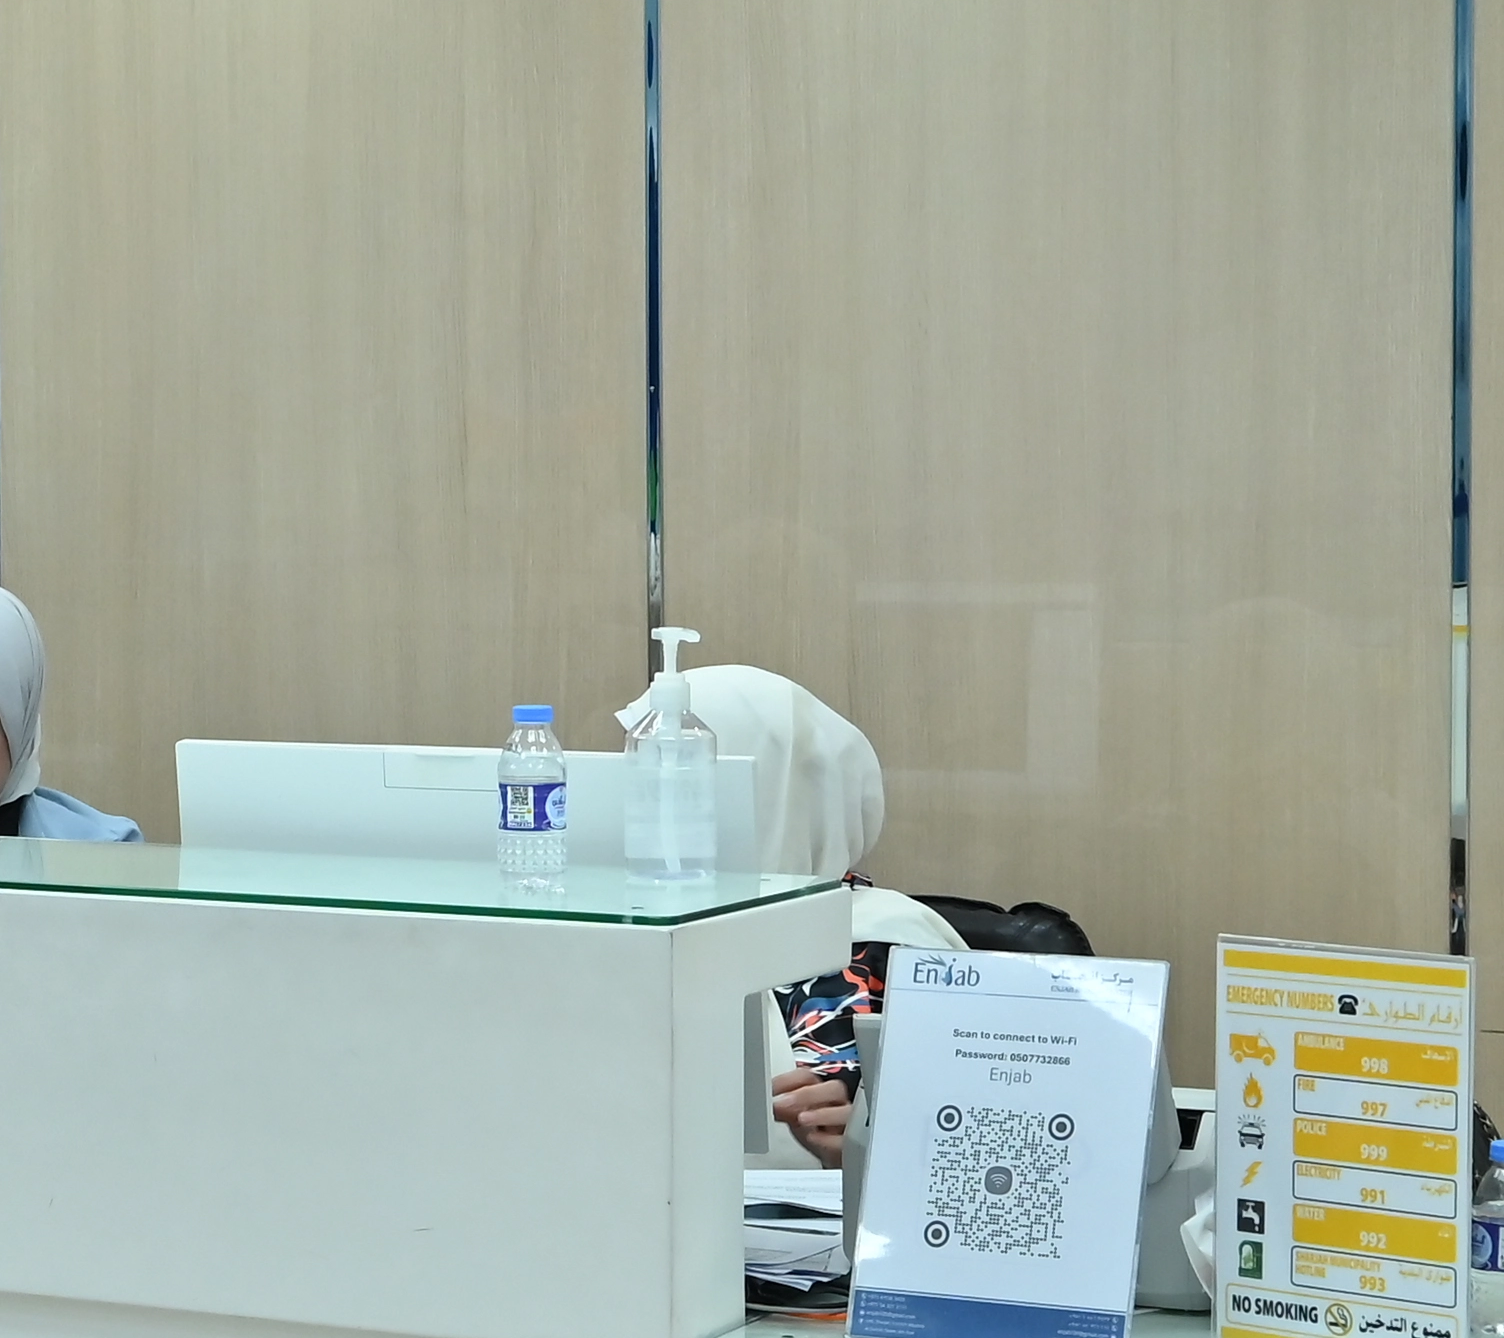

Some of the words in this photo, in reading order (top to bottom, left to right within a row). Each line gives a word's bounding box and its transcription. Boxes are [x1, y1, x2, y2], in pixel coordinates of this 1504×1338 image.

[913, 957, 981, 988] Enjab
[1227, 984, 1285, 1008] EMERGENCY
[1287, 993, 1335, 1013] NUMBERS
[953, 1028, 978, 1039] Scan
[980, 1030, 991, 1040] to
[993, 1032, 1036, 1044] connect
[1037, 1035, 1049, 1045] to
[1050, 1035, 1077, 1046] Wi-Fi
[1298, 1034, 1345, 1050] AMBULANCE
[955, 1049, 1007, 1062] Password:
[1010, 1053, 1071, 1066] 0507732866
[1361, 1057, 1389, 1074] 998
[989, 1067, 1032, 1086] Enjab
[1297, 1077, 1316, 1092] FIRE
[1361, 1101, 1388, 1118] 997
[1296, 1120, 1327, 1135] POLICE
[1360, 1144, 1388, 1161] 999
[1296, 1165, 1342, 1181] ELECTRICITY
[1360, 1187, 1387, 1204] 991
[1296, 1206, 1325, 1221] WATER
[1359, 1232, 1387, 1249] 992
[1295, 1264, 1326, 1278] HOTLINE
[1329, 1256, 1381, 1272] MUNICIPALITY
[1359, 1275, 1387, 1292] 993
[1232, 1294, 1252, 1314] NO
[1254, 1298, 1319, 1324] SMOKING
[1358, 1313, 1407, 1334] التدخين
